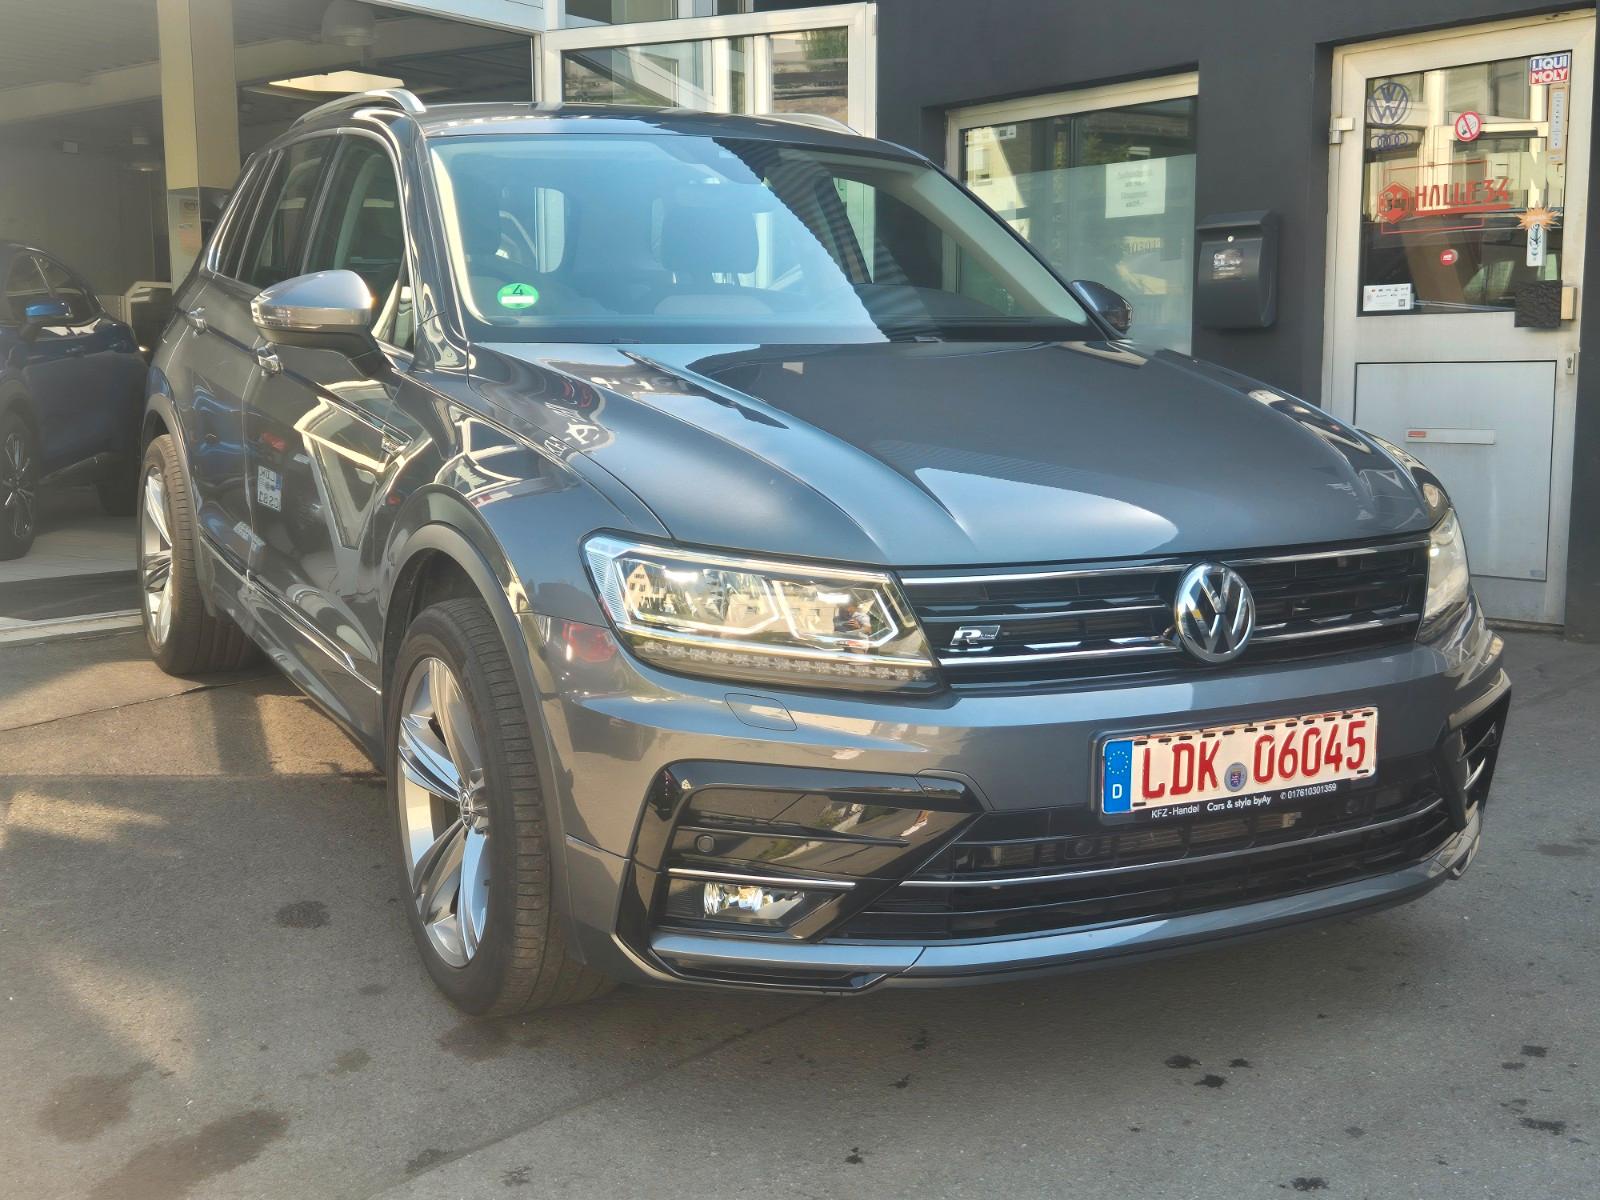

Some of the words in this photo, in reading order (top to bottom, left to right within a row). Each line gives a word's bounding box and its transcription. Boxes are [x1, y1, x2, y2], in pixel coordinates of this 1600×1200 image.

[1532, 56, 1567, 71] LIQUI
[1532, 68, 1567, 83] MOLY
[512, 284, 524, 296] 4
[1141, 738, 1222, 799] LDK
[1253, 720, 1367, 784] 06045
[1112, 783, 1123, 799] D
[1206, 802, 1225, 811] Cars
[1226, 799, 1233, 809] &
[1234, 797, 1251, 808] style
